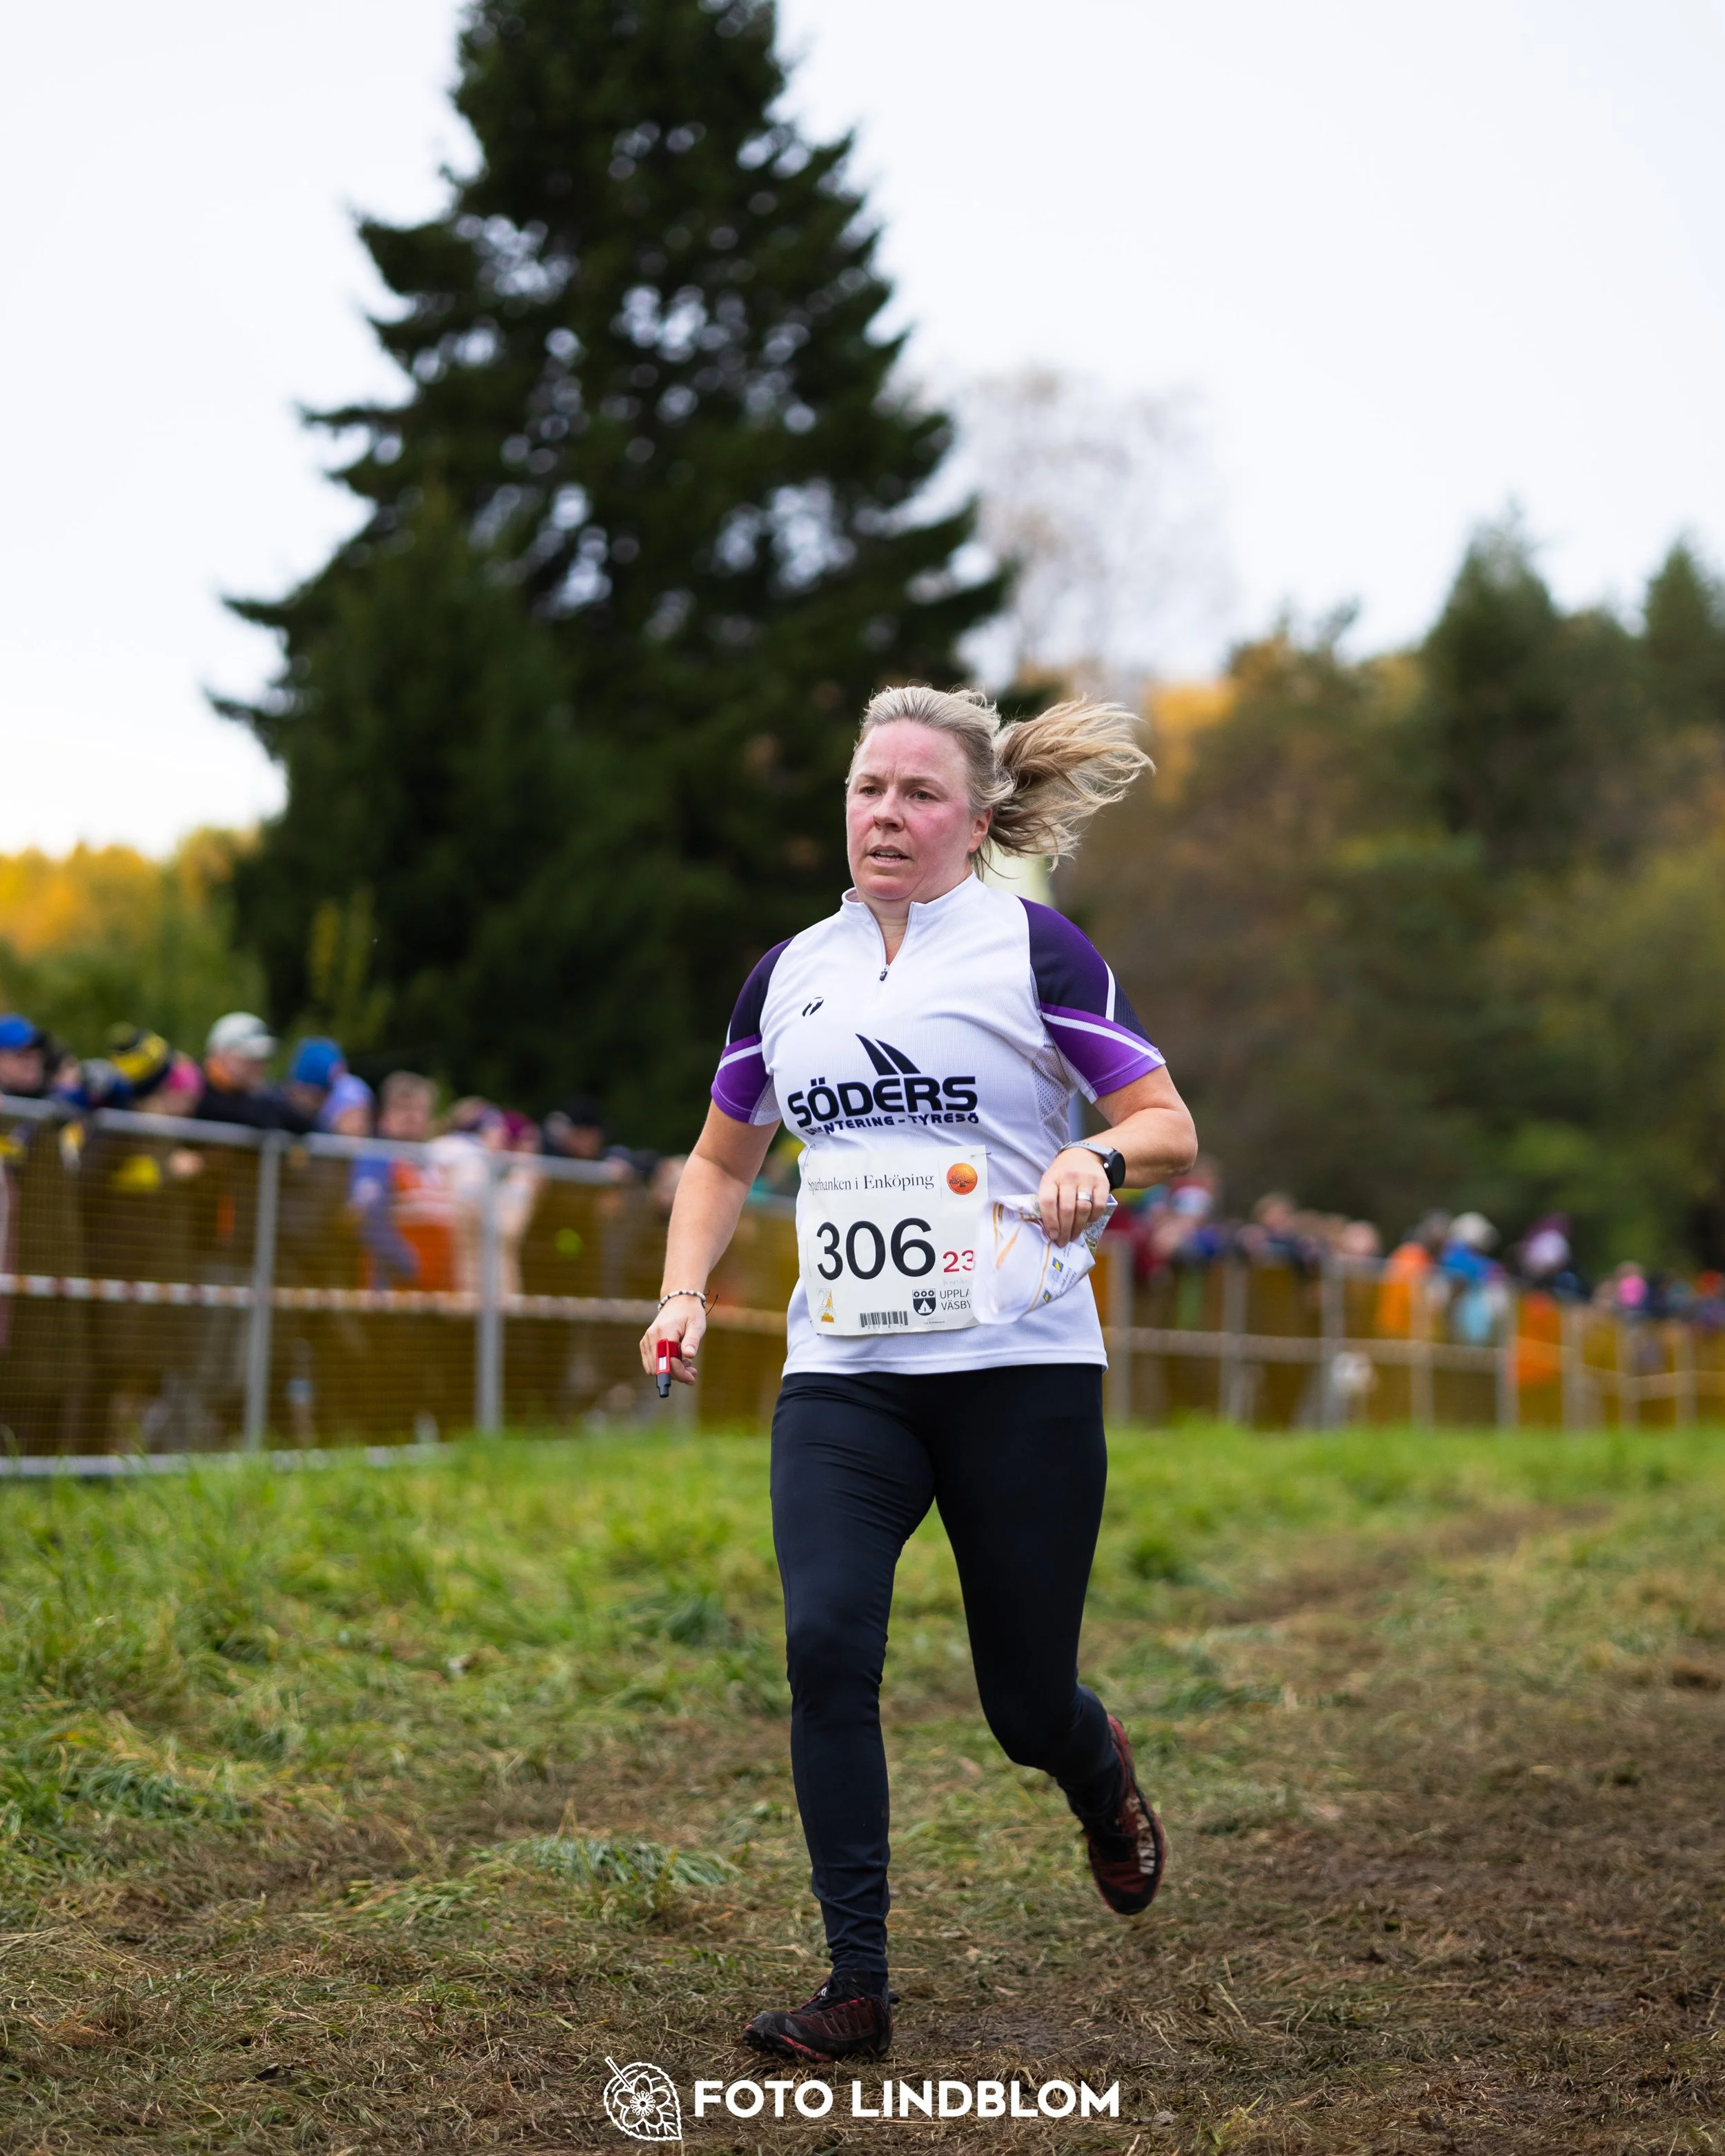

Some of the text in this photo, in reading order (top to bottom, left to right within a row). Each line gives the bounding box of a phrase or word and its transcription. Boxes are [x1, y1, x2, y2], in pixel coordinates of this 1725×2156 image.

[787, 1076, 978, 1128] SÖDERS
[807, 1174, 934, 1196] Sparbanken i Enköping
[816, 1217, 976, 1280] 306 23
